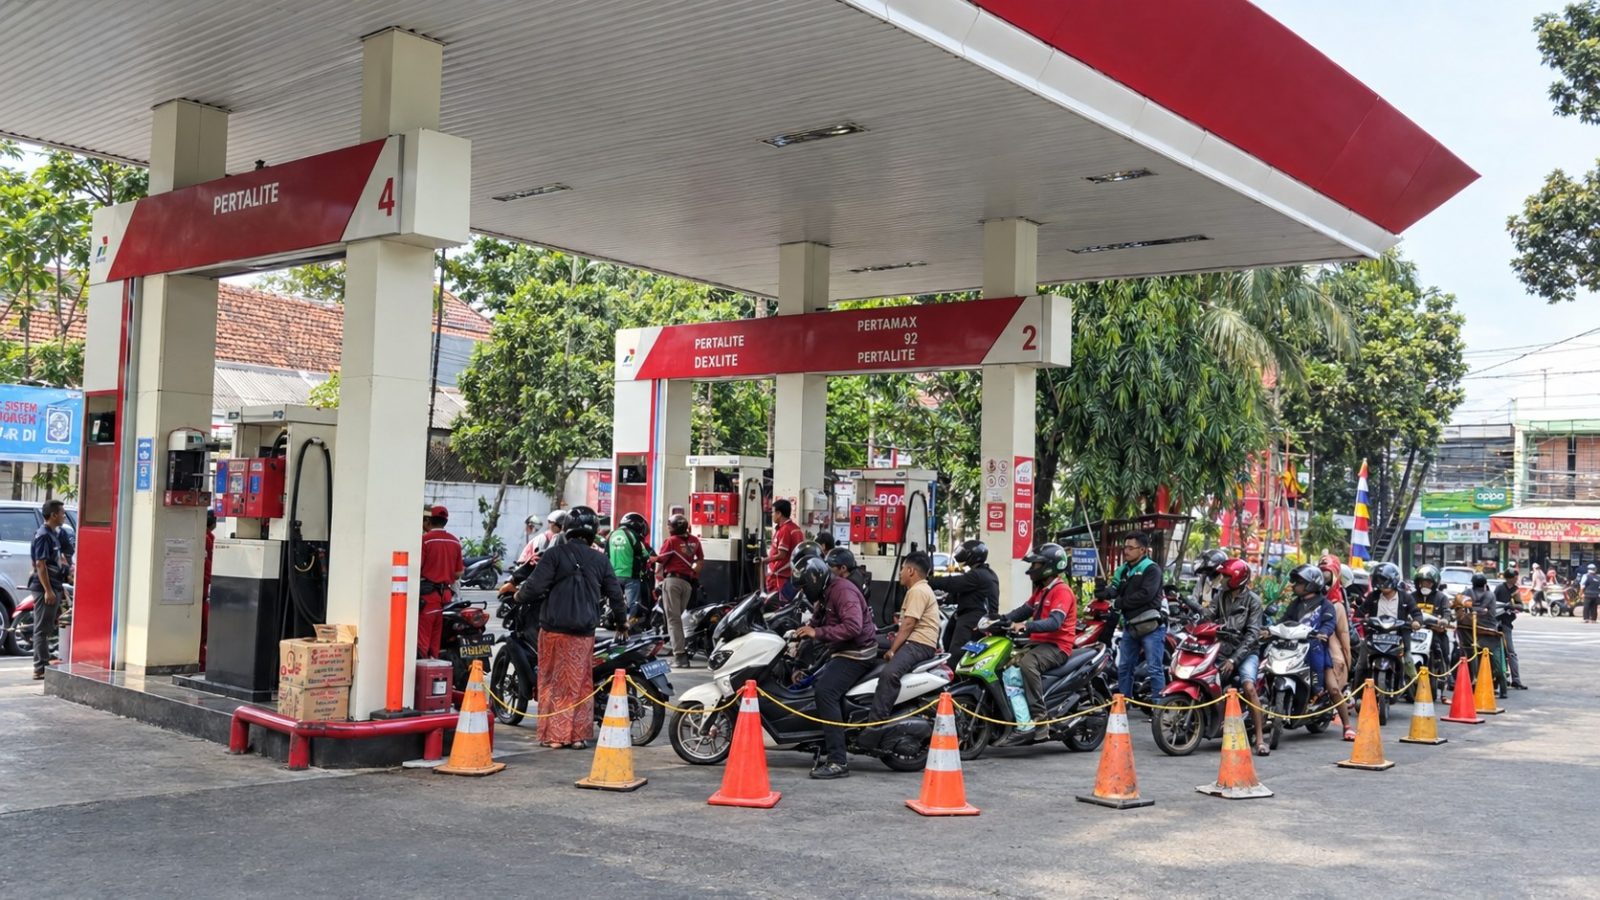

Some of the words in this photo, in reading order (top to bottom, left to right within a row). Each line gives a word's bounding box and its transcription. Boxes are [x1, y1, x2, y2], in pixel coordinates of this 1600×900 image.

[213, 182, 280, 216] PERTALITE
[378, 177, 395, 217] 4
[857, 316, 918, 332] PERTAMAX
[694, 335, 745, 350] PERTALITE
[903, 332, 918, 346] 92
[1022, 324, 1037, 351] 2
[694, 353, 739, 369] DEXLITE
[857, 348, 916, 364] PERTALITE
[5, 400, 37, 413] SISTEM
[22, 428, 37, 443] DI
